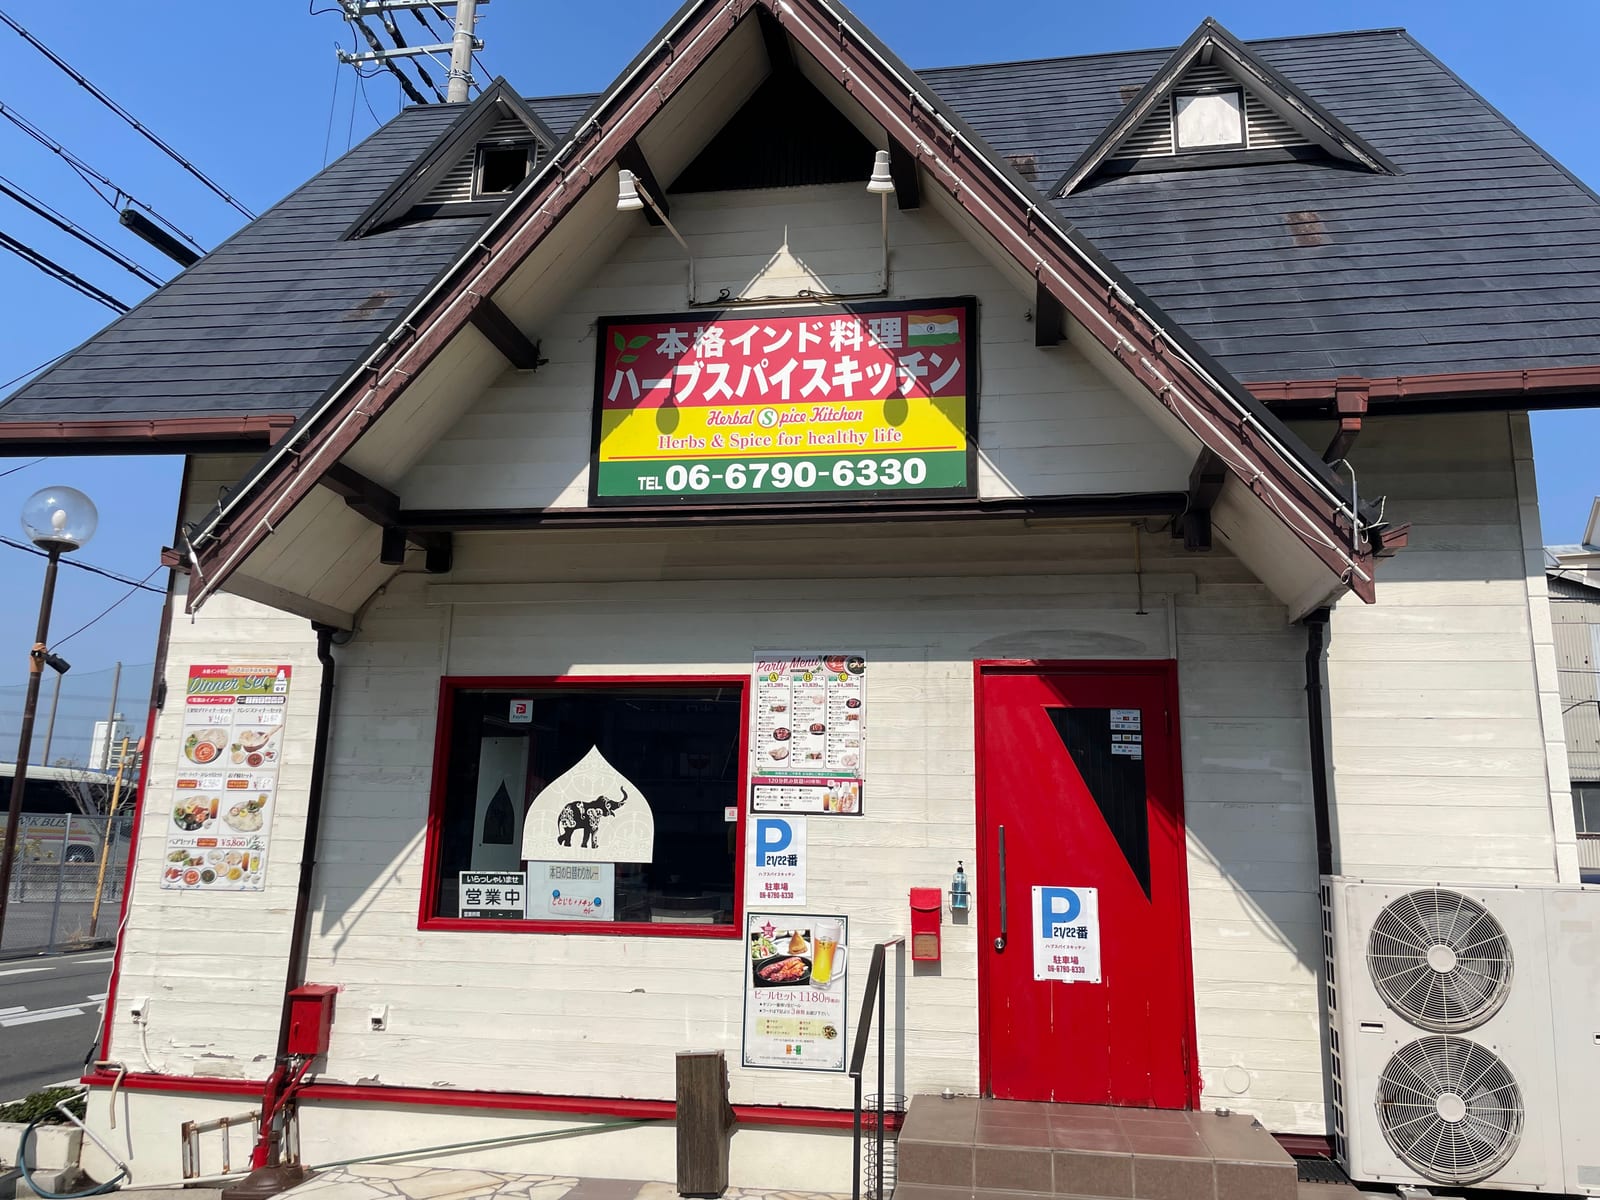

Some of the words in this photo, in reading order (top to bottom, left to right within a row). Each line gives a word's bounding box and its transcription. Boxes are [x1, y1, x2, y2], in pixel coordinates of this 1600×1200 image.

[656, 317, 904, 360] 本格インド料理
[607, 352, 961, 403] ハーブスパイスキッチン
[706, 406, 753, 427] Herbal
[810, 406, 864, 423] Kitchen
[657, 434, 706, 451] Herbs
[711, 434, 725, 449] &
[729, 432, 772, 451] Spice
[777, 431, 803, 447] for
[808, 429, 868, 449] healthy
[874, 428, 902, 443] life
[637, 475, 663, 491] TEL
[665, 457, 928, 491] 06-6790-6330
[756, 660, 787, 675] Party
[789, 656, 819, 669] Menu
[187, 676, 240, 694] Dinner
[242, 674, 271, 690] Set
[756, 819, 793, 867] P
[766, 854, 798, 867] 21/22番
[466, 875, 519, 884] いらっしゃいませ
[765, 882, 789, 891] 駐車場
[465, 887, 520, 906] 営業中
[1041, 887, 1081, 939] P
[1053, 926, 1088, 939] 21/22番
[1053, 955, 1079, 965] 駐車場
[754, 990, 797, 1001] ビールセット
